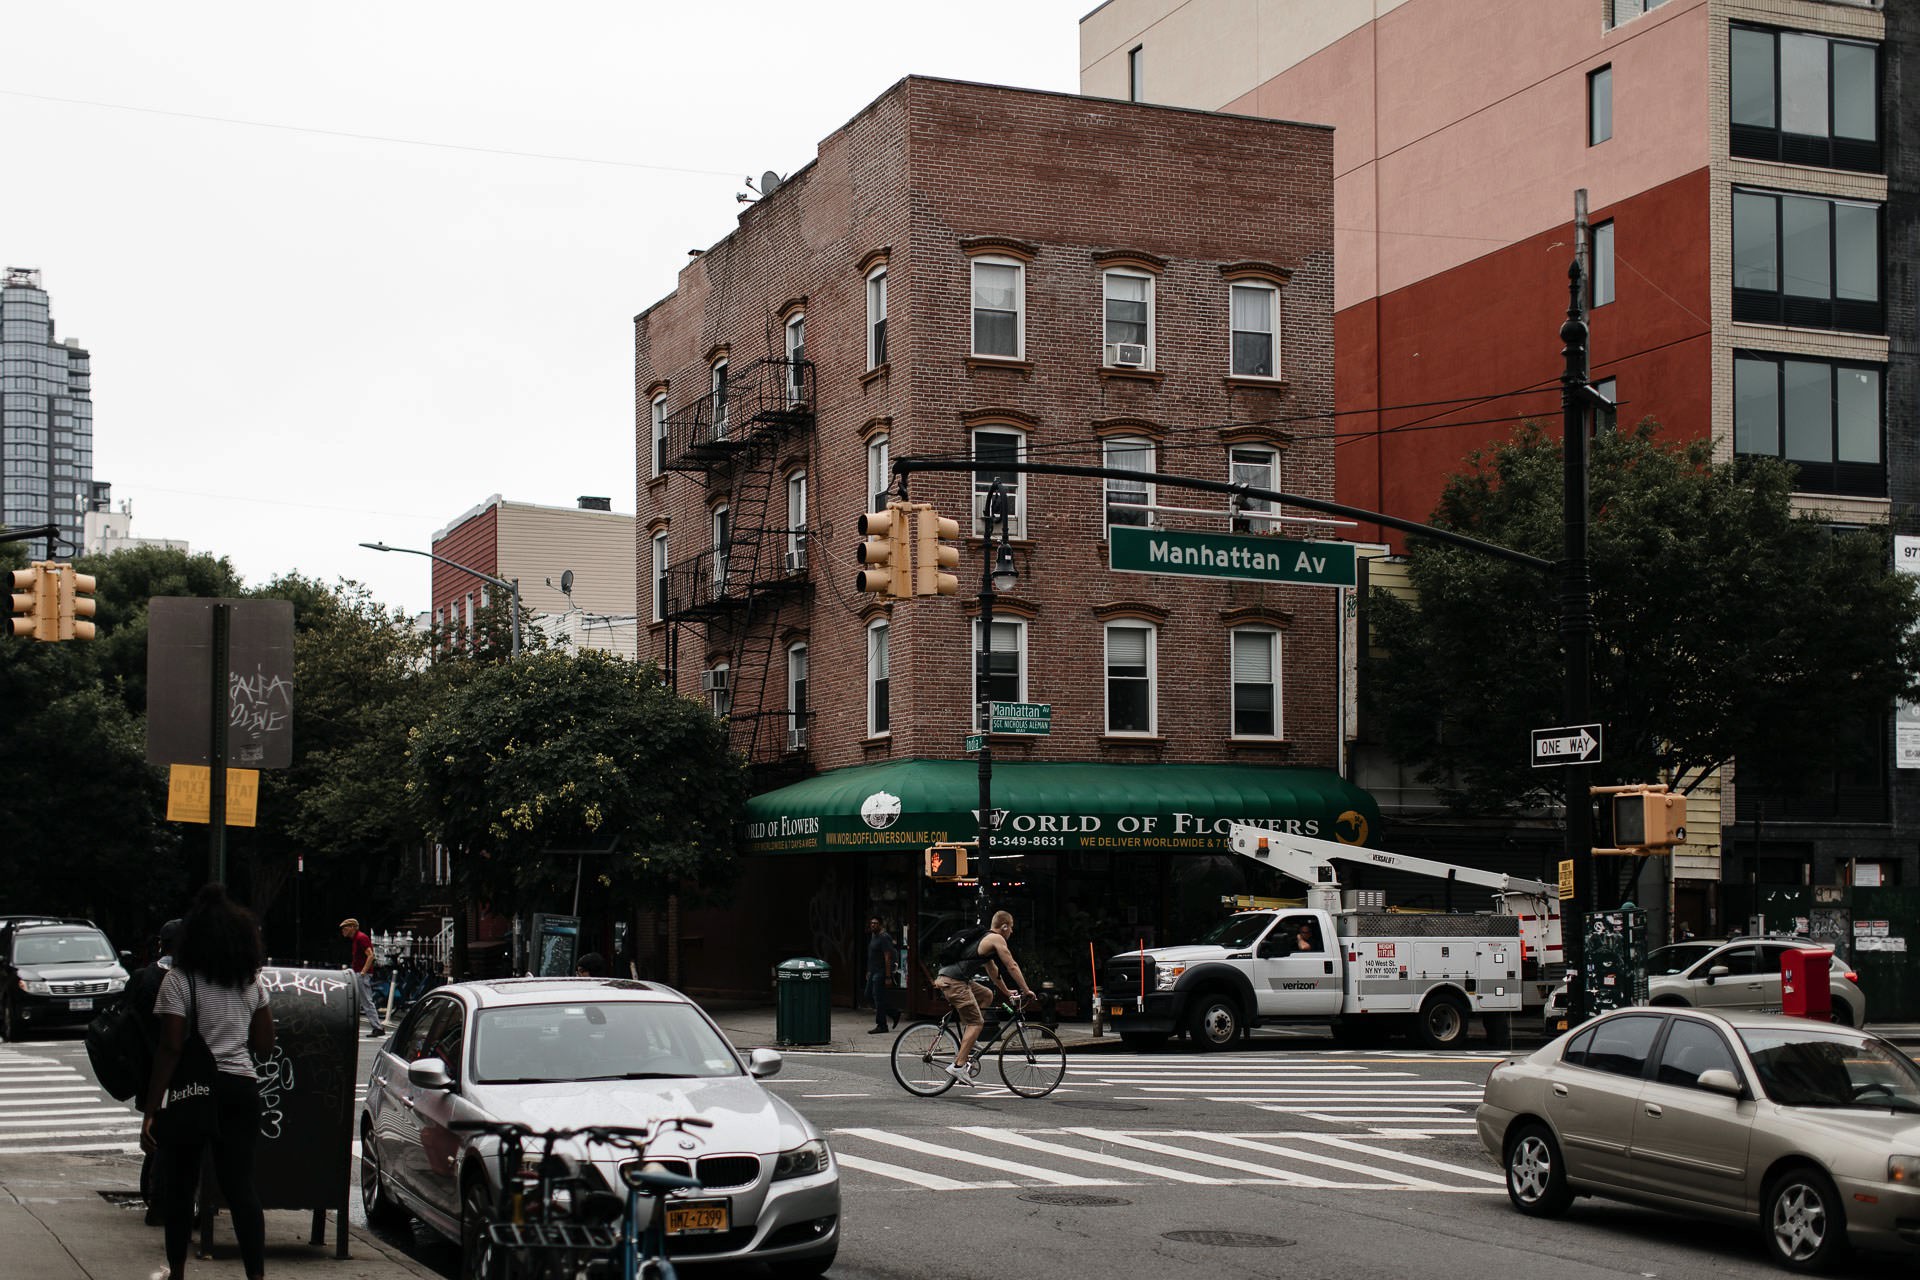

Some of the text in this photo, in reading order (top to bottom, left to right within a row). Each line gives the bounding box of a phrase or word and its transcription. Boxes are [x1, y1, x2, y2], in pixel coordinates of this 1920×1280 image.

[1149, 540, 1326, 574] Manhattan Av
[993, 703, 1040, 718] Manhattan
[1004, 720, 1028, 729] NICHOLAS
[1028, 721, 1048, 729] ALEMAN
[1541, 737, 1591, 755] ONE WAY
[745, 816, 819, 839] ORLD OF FLOWERS
[1117, 816, 1158, 833] OF
[826, 831, 948, 845] WWW.WORLDOFFLOWERSONLINE.COM
[972, 836, 1064, 846] 78-349-8631
[1080, 837, 1096, 847] WE
[1098, 837, 1141, 847] DELIVER
[1143, 838, 1205, 848] WORLDWIDE
[1206, 839, 1214, 848] &
[1216, 839, 1222, 848] 7
[1372, 854, 1395, 865] VERSALIFT
[1282, 980, 1315, 990] verizon
[170, 1081, 210, 1103] Berklee
